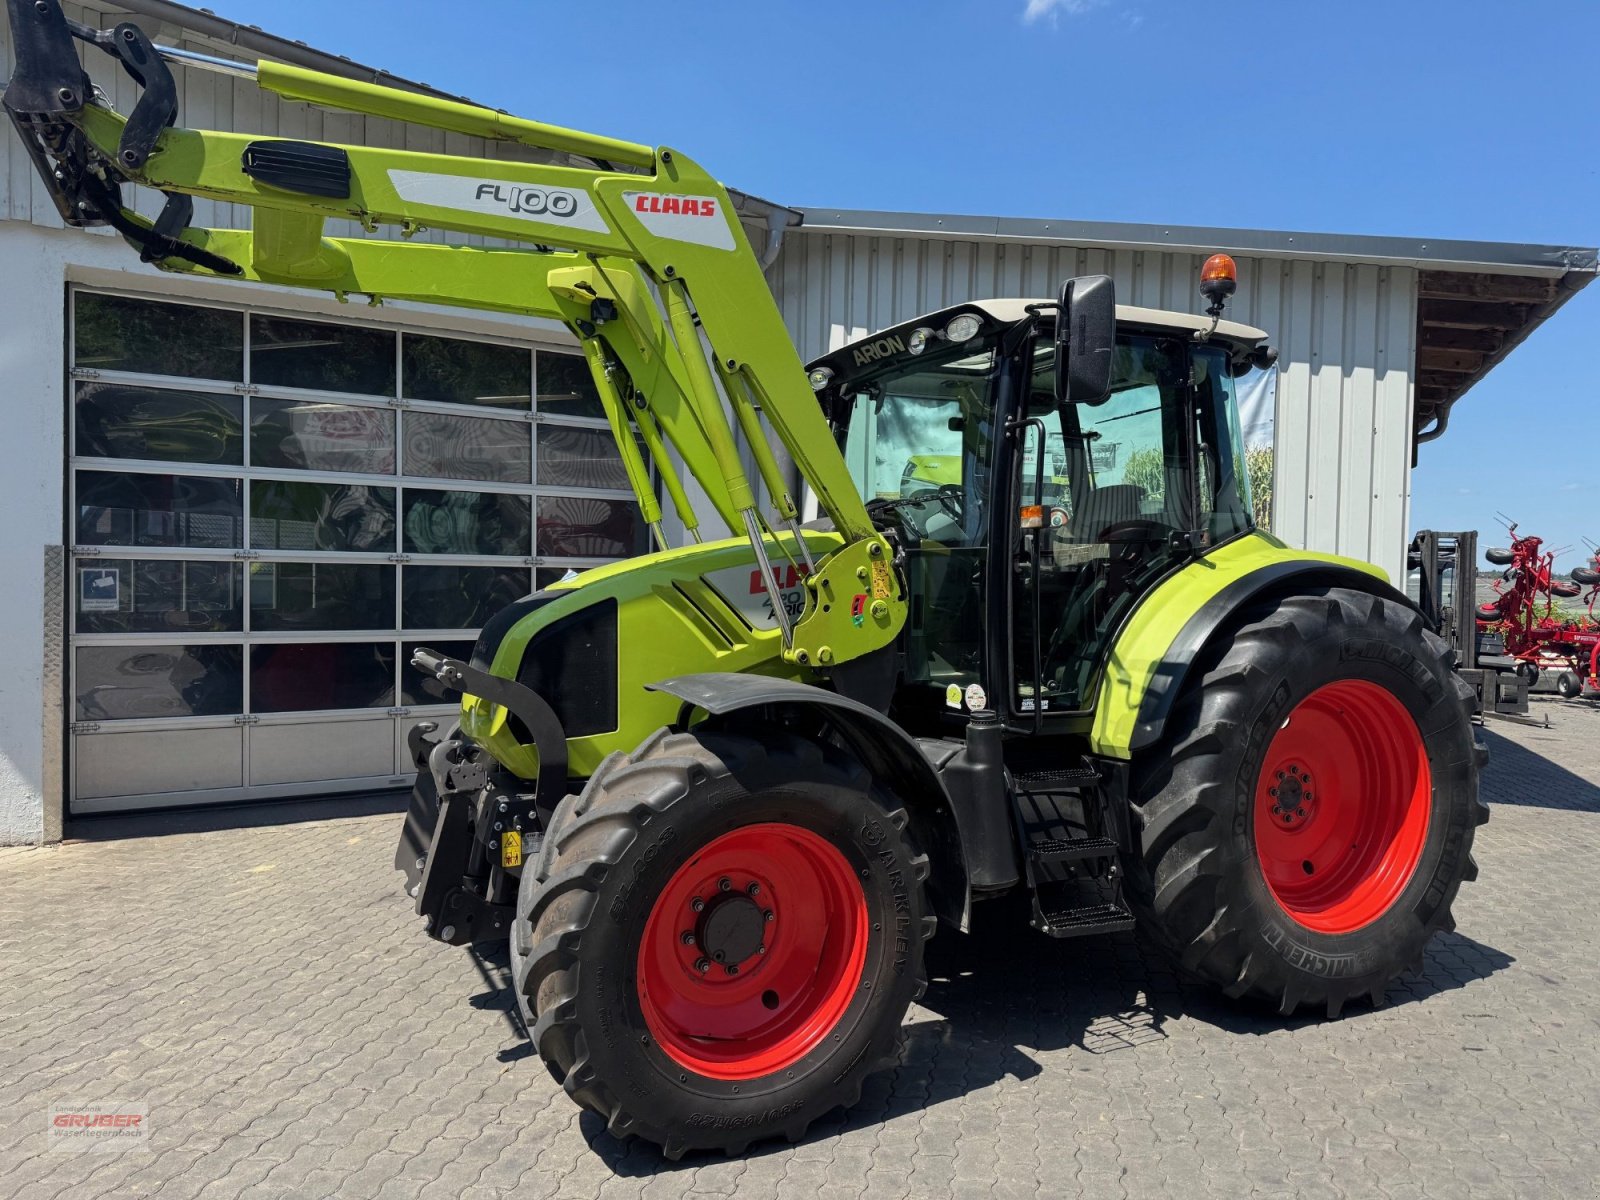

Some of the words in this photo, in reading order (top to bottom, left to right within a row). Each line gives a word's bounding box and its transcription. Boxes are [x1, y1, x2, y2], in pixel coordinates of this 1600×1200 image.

[635, 195, 715, 217] CLAAS
[852, 334, 906, 367] ARION
[1259, 921, 1356, 978] MICHELIN
